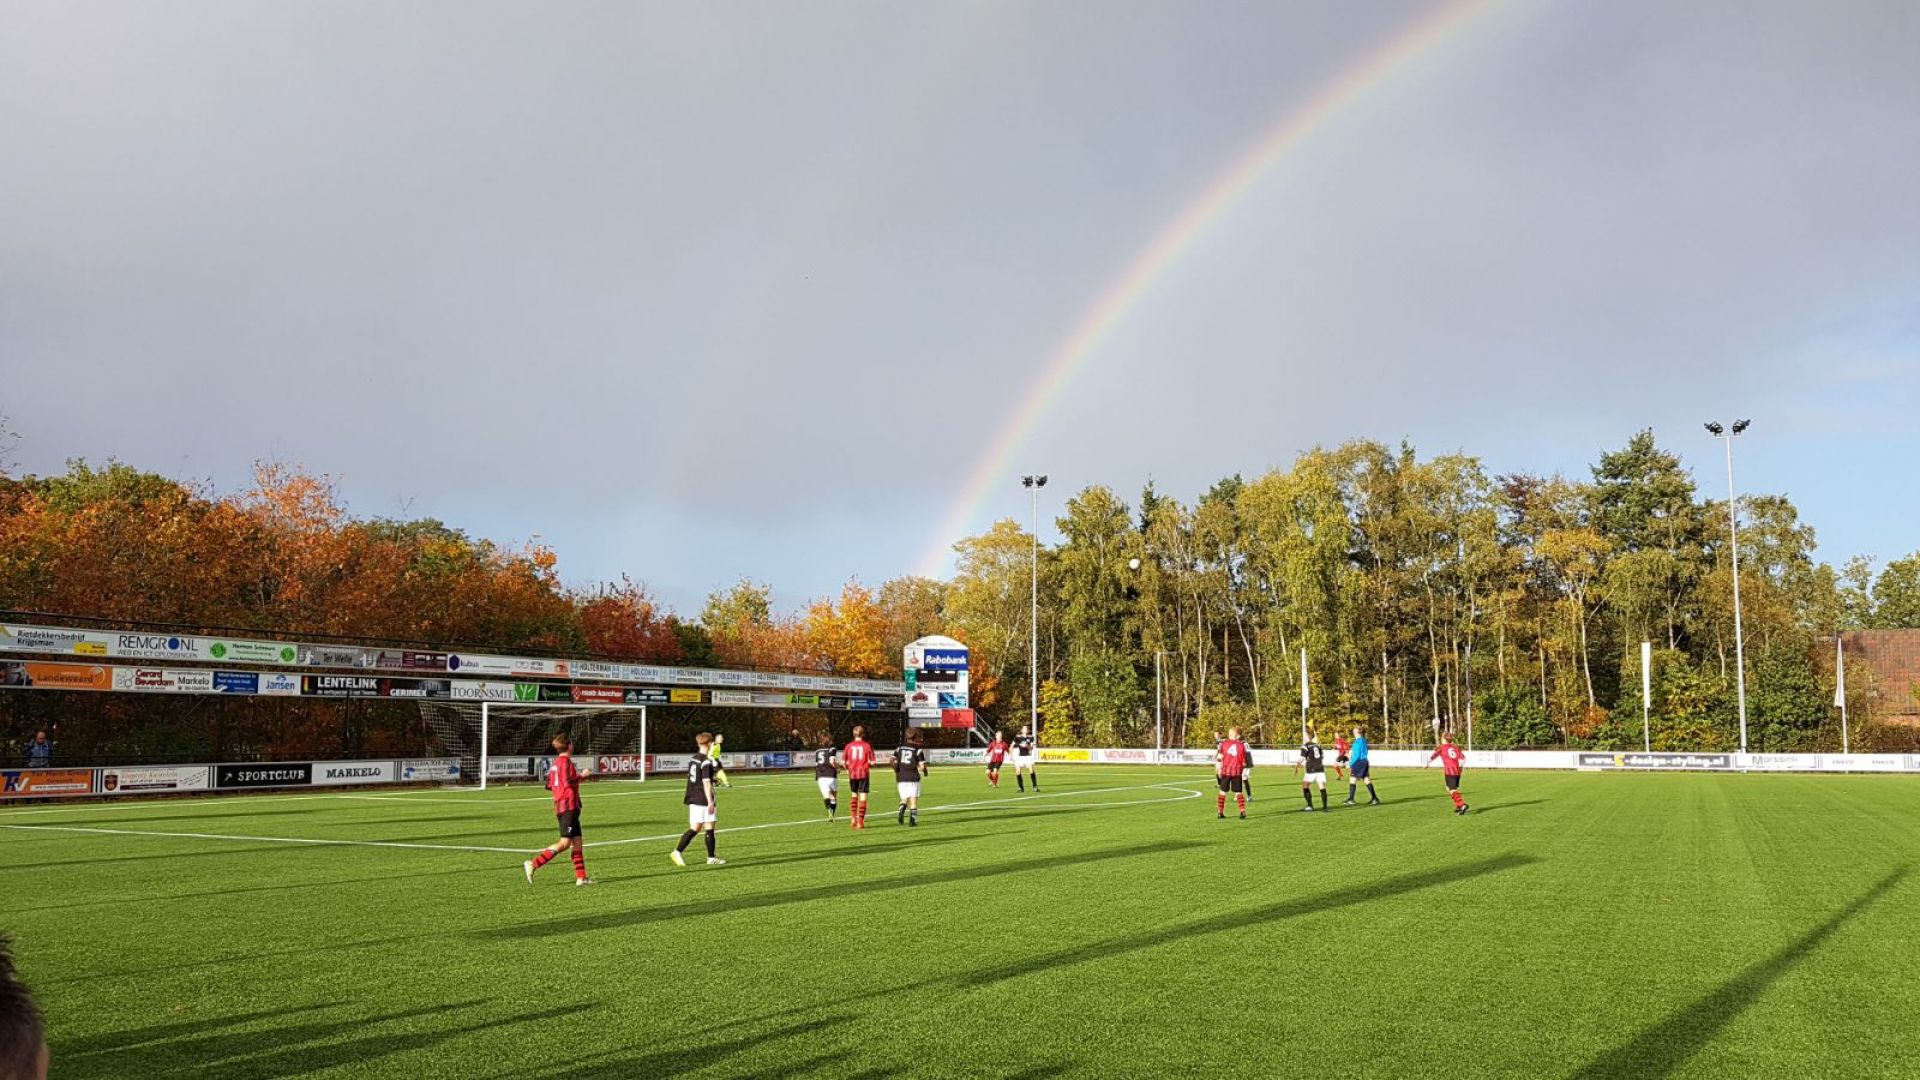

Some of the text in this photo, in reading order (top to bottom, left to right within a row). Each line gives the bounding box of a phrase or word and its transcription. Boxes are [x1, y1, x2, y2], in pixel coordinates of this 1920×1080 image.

[925, 655, 967, 664] Rabobank
[178, 676, 209, 685] Markelo
[265, 680, 295, 690] Jansen
[317, 677, 377, 689] LENTELINK
[390, 688, 427, 697] GERIMEX
[850, 746, 864, 759] 11
[1227, 744, 1237, 756] 4
[1447, 747, 1457, 759] 6
[817, 752, 825, 764] 5
[900, 750, 911, 763] 12
[326, 767, 381, 778] MARKELO
[689, 759, 697, 778] 9
[238, 770, 305, 781] SPORTCLUB
